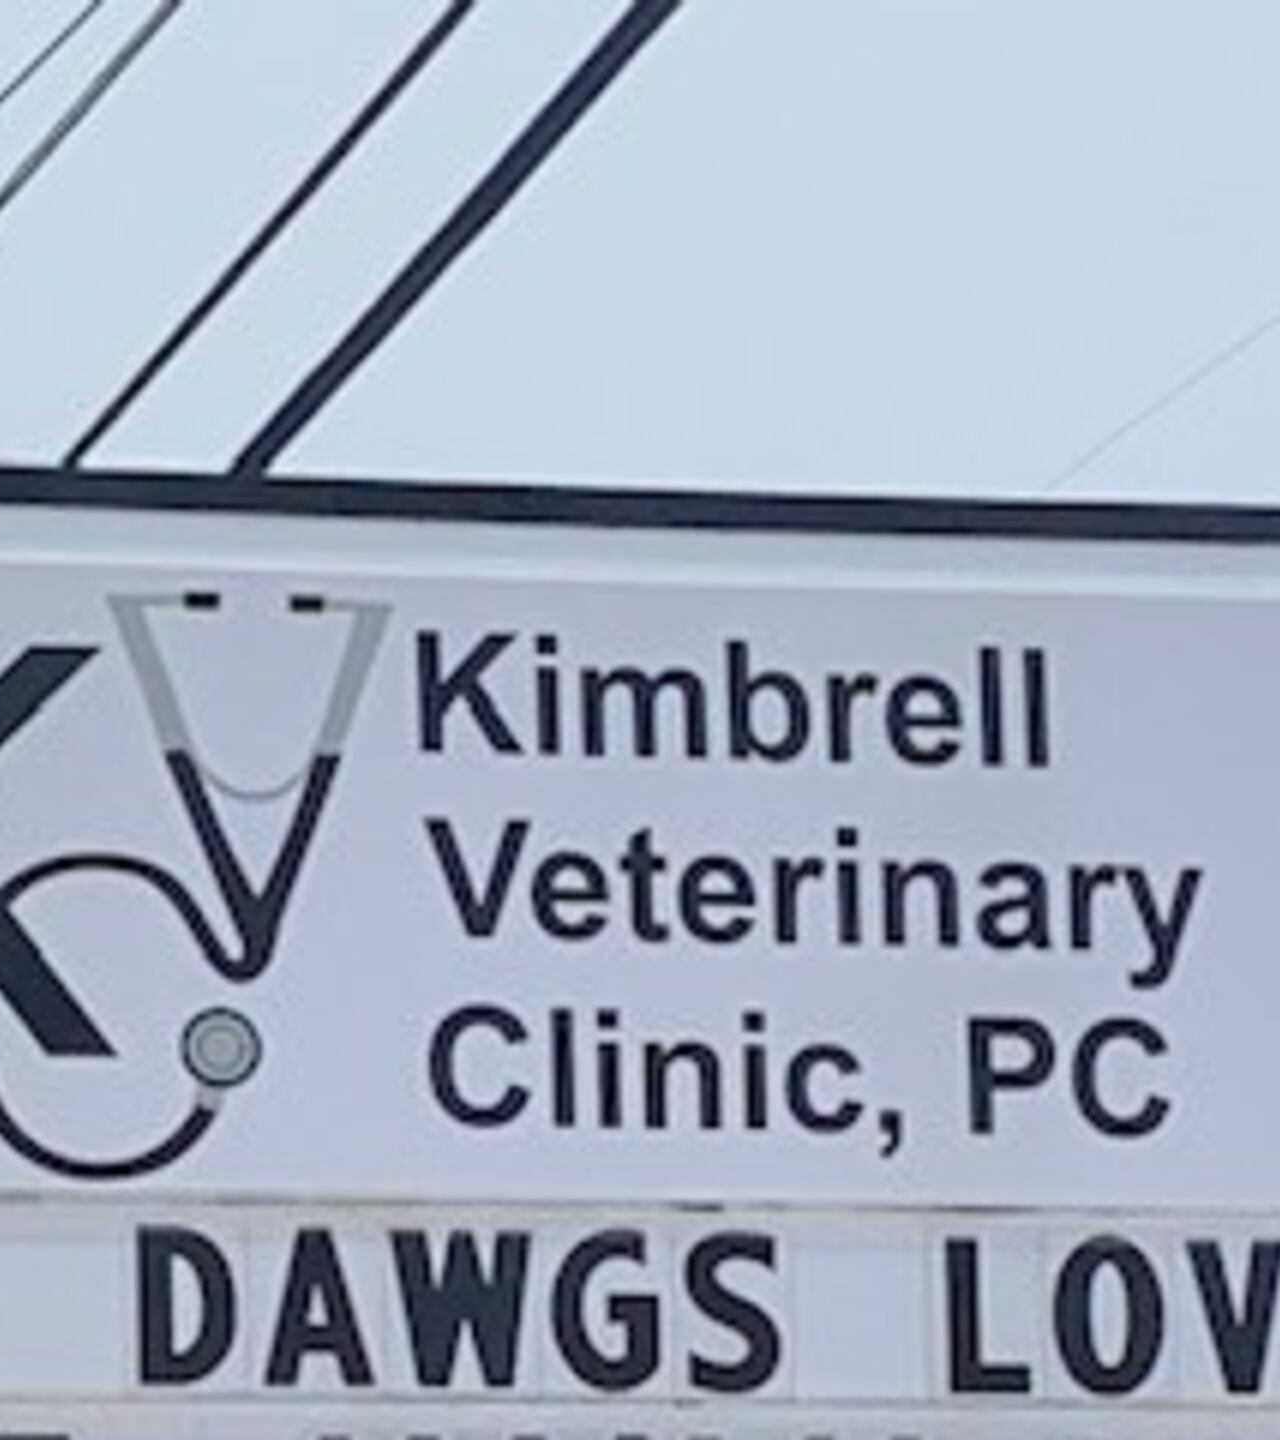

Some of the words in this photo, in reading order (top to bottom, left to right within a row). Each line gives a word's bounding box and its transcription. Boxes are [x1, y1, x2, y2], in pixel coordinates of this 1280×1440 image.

[416, 631, 1048, 768] Kimbrell
[425, 818, 1203, 990] Veterinary
[428, 1004, 902, 1158] Clinic,
[967, 1016, 1170, 1138] PC
[136, 1223, 781, 1394] DAWGS
